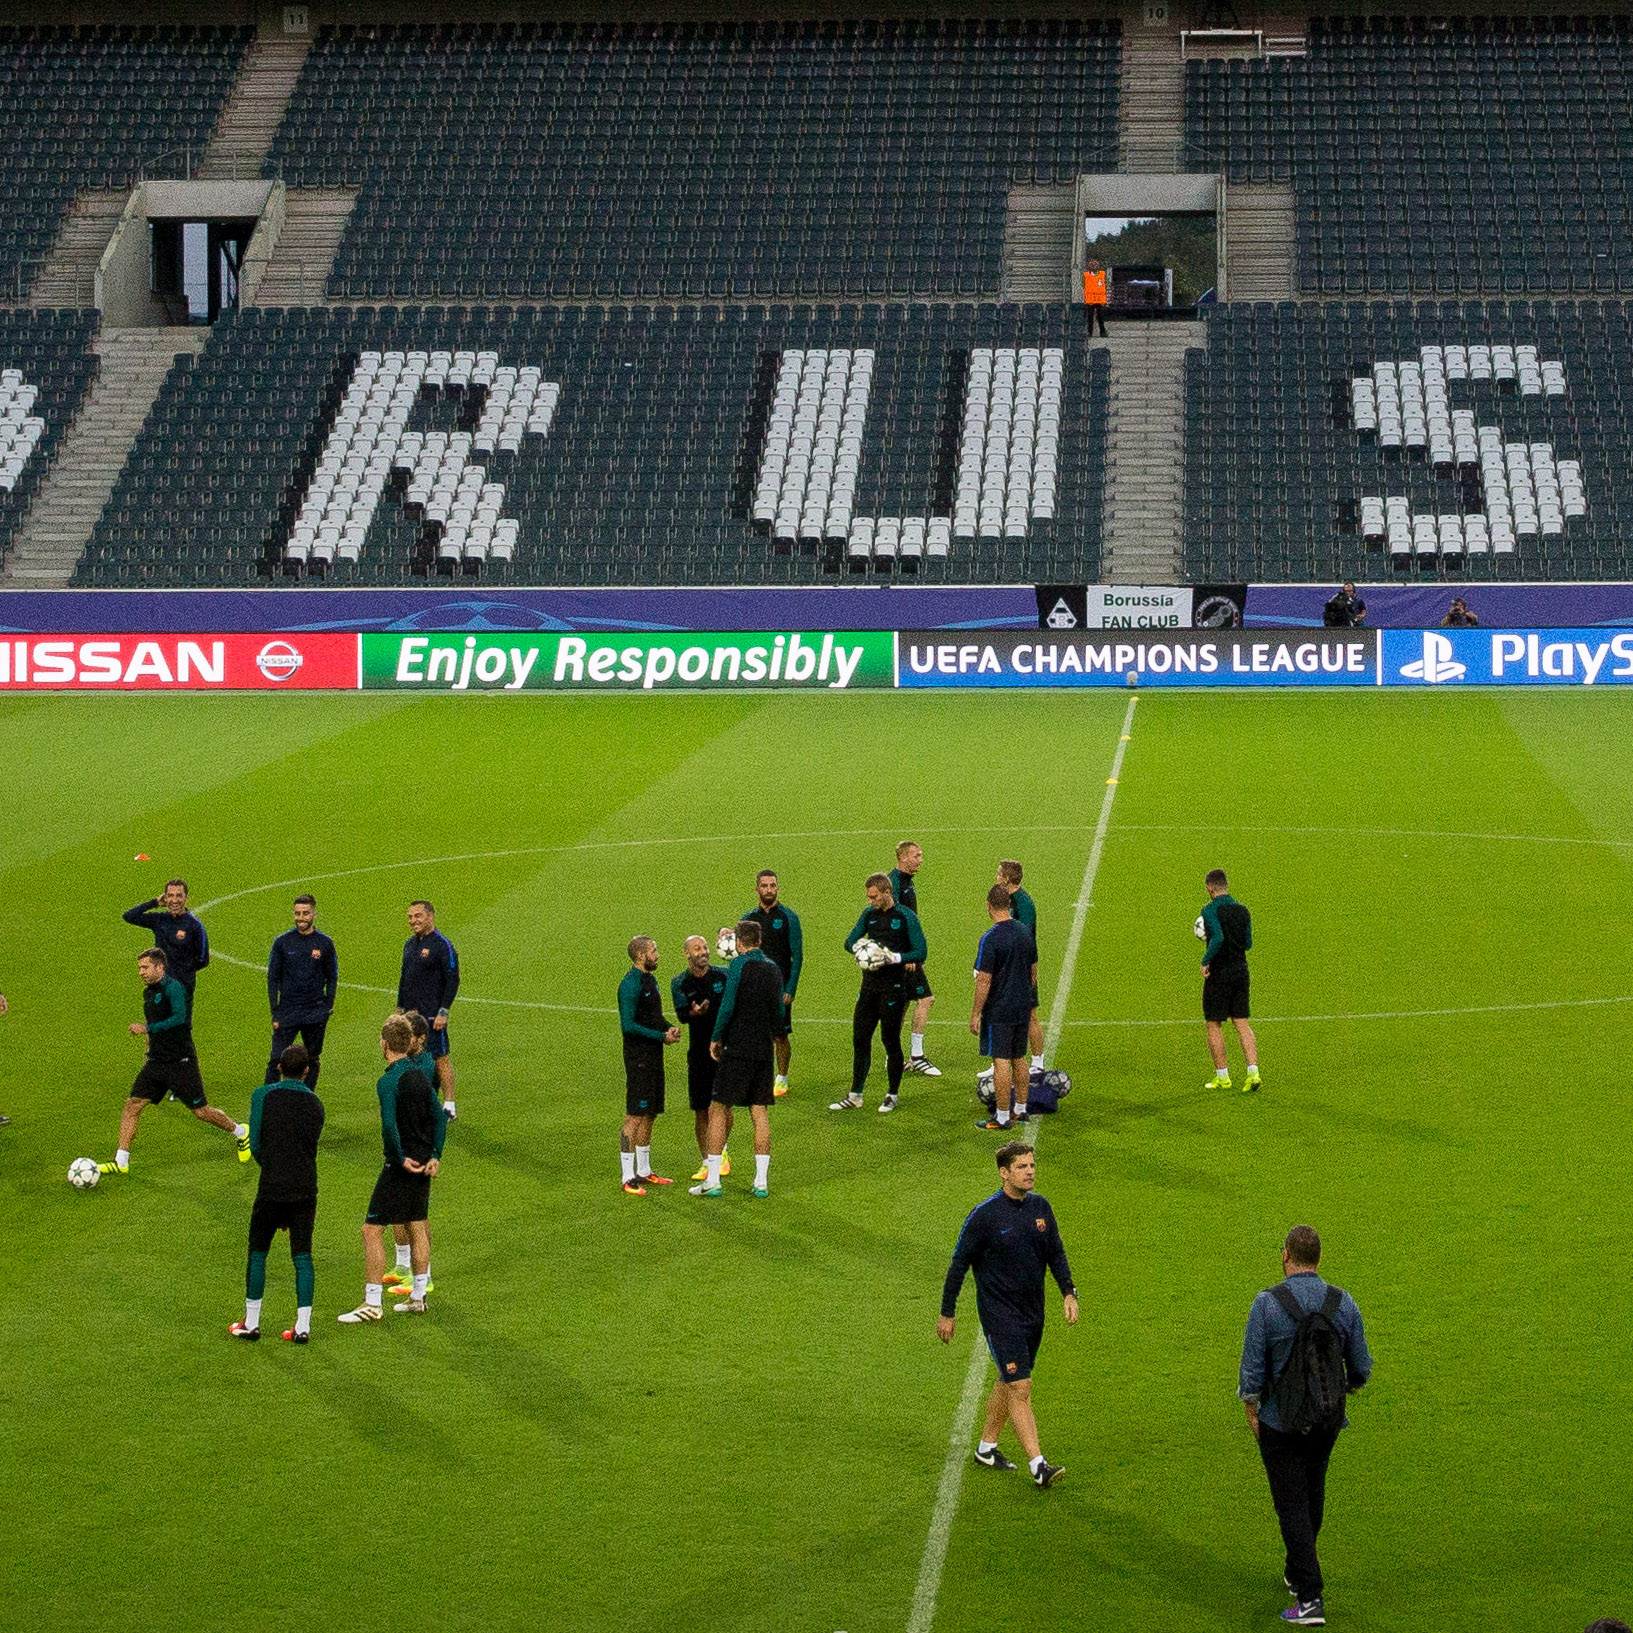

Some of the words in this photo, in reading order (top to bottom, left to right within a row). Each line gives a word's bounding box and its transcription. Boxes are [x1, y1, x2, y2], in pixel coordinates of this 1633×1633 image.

[289, 14, 304, 25] 11
[1148, 7, 1164, 19] 10
[1103, 593, 1174, 607] Borussia
[1102, 616, 1132, 628] FAN
[1137, 615, 1179, 628] CLUB
[395, 637, 541, 689] Enjoy
[554, 634, 863, 688] Responsibly
[910, 645, 1001, 673] UEFA
[1011, 644, 1218, 673] CHAMPIONS
[1233, 643, 1365, 672] LEAGUE
